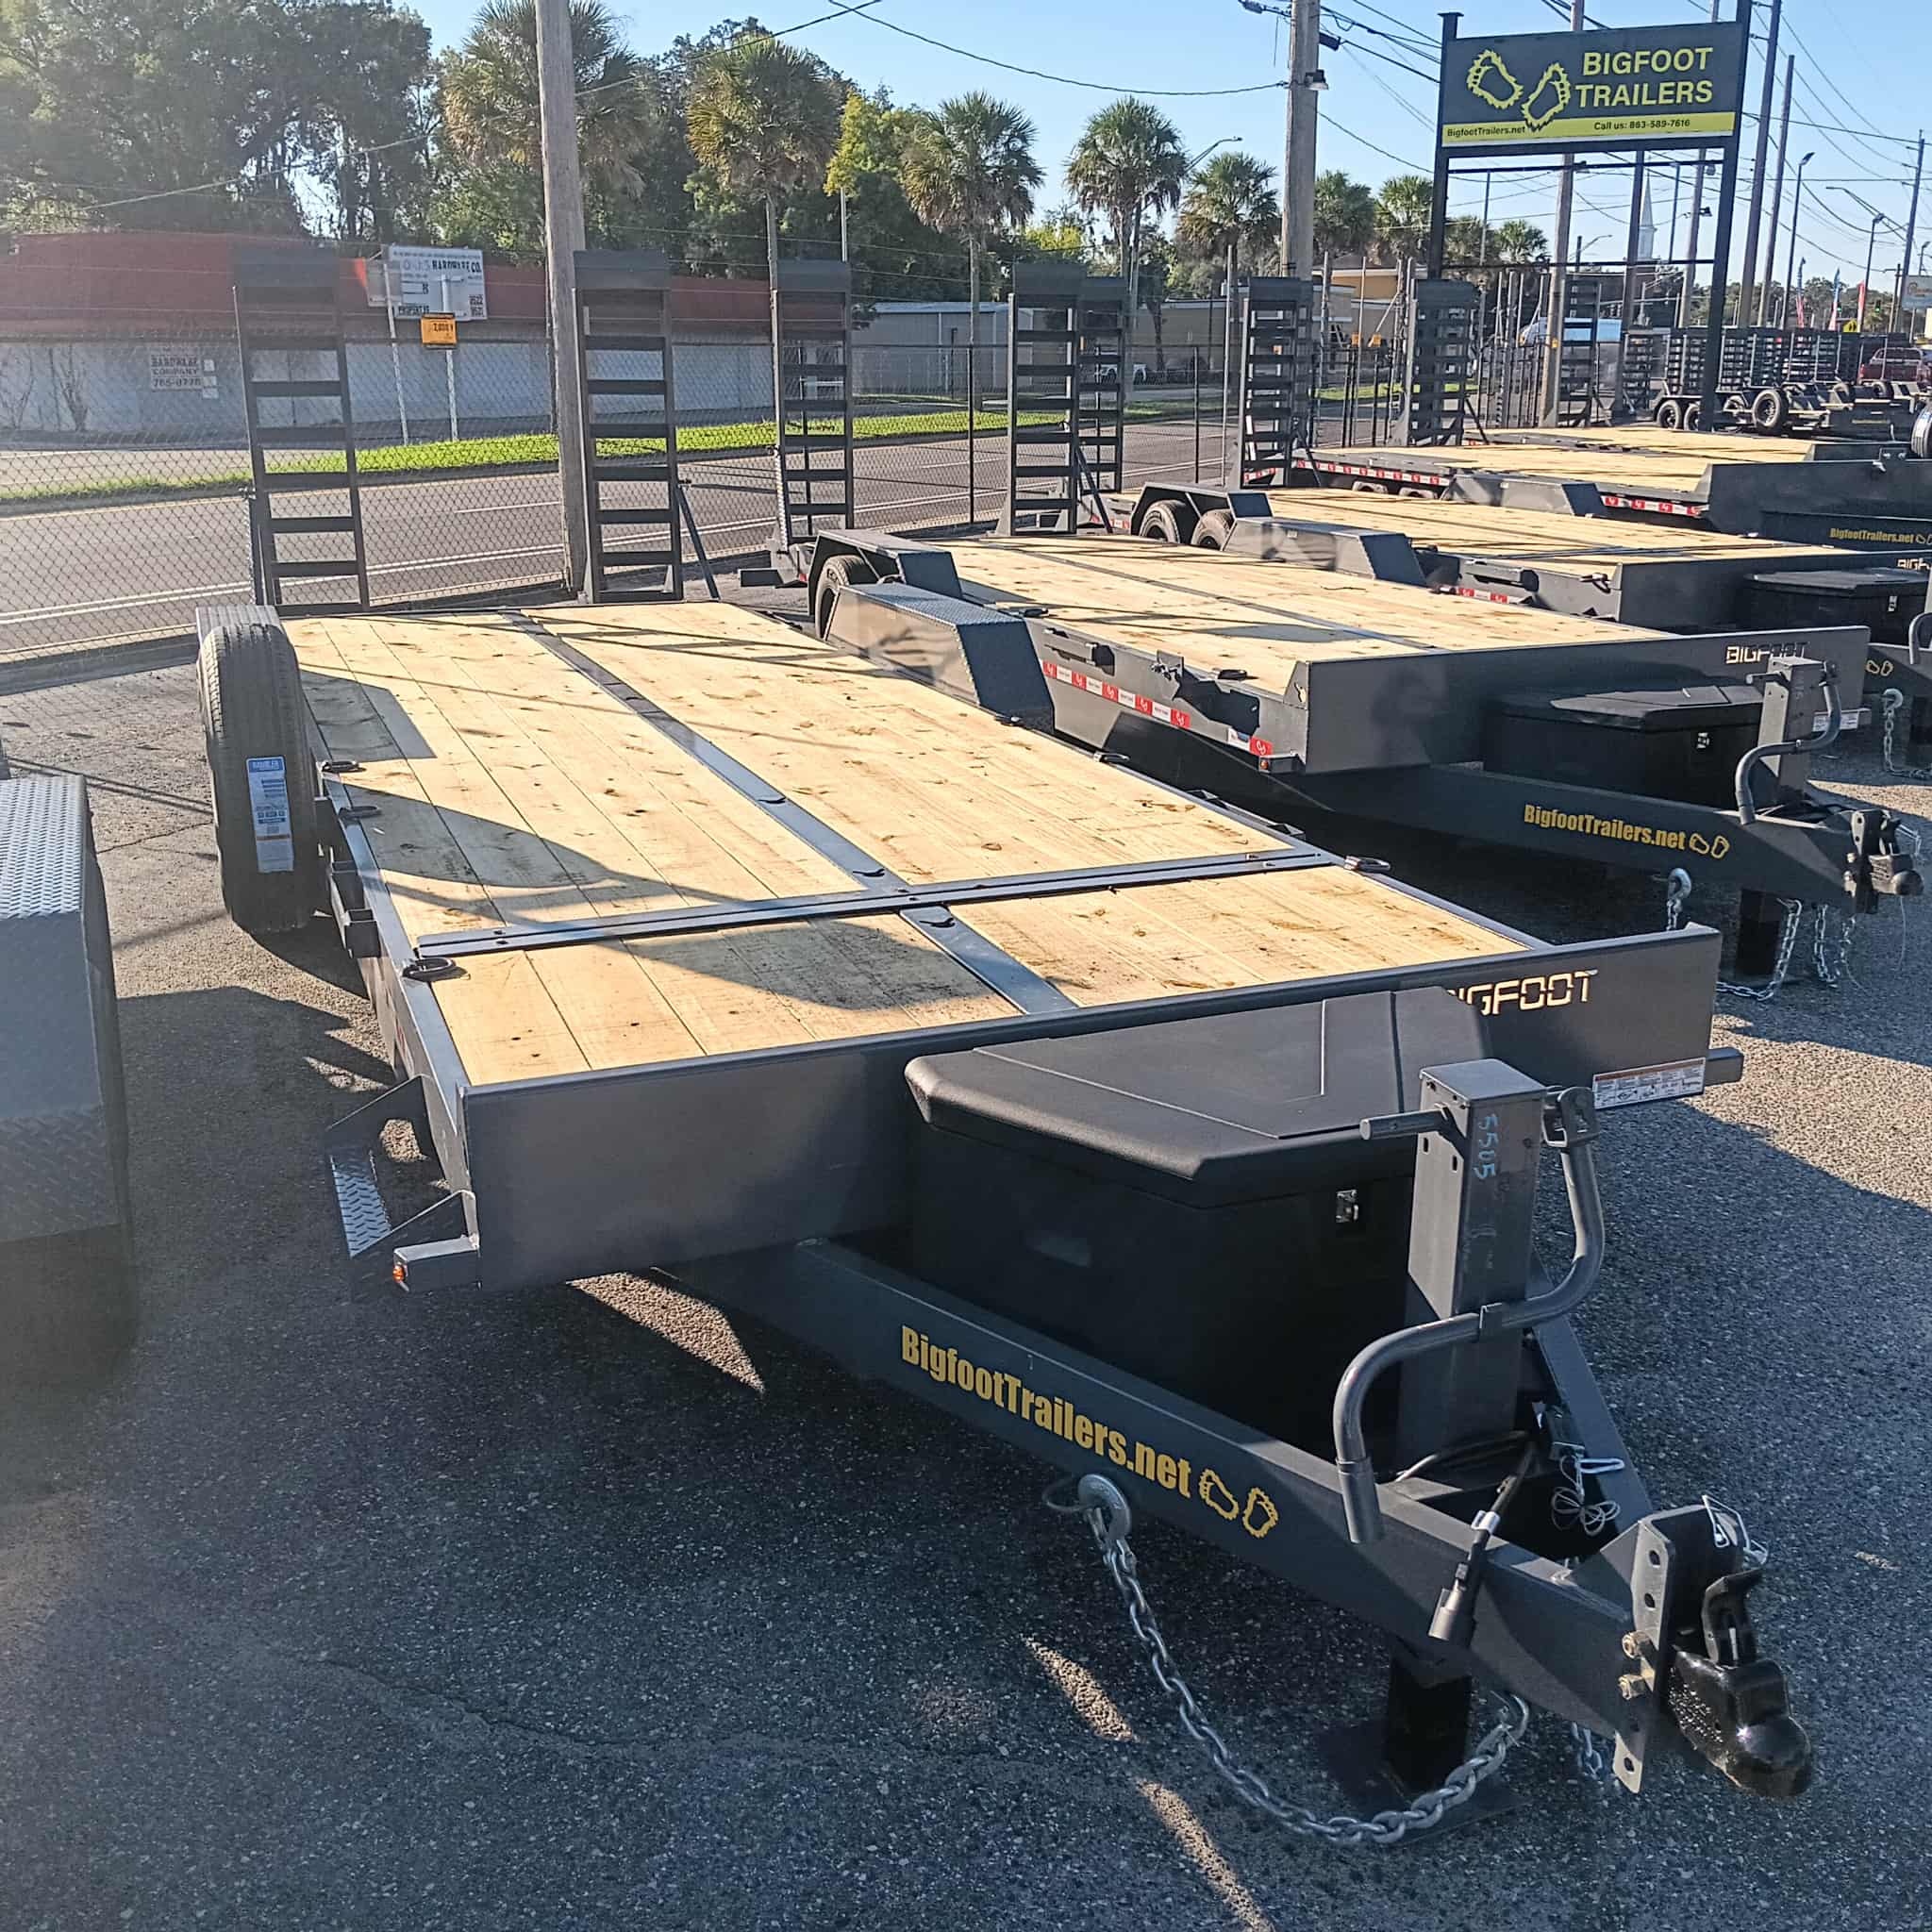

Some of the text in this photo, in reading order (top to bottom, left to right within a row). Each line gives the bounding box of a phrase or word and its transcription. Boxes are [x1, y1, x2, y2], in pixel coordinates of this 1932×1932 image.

[1582, 47, 1714, 76] BIGFOOT
[1574, 79, 1714, 108] TRAILERS
[1447, 125, 1525, 139] BigfootTrailers.net
[1593, 122, 1612, 130] Call
[1828, 527, 1915, 544] BigfootTrailers.net
[1524, 804, 1685, 850] BigfootTrailers.net
[1449, 969, 1599, 1017] GFOOT
[901, 1324, 1192, 1499] BigfootTrailers.net
